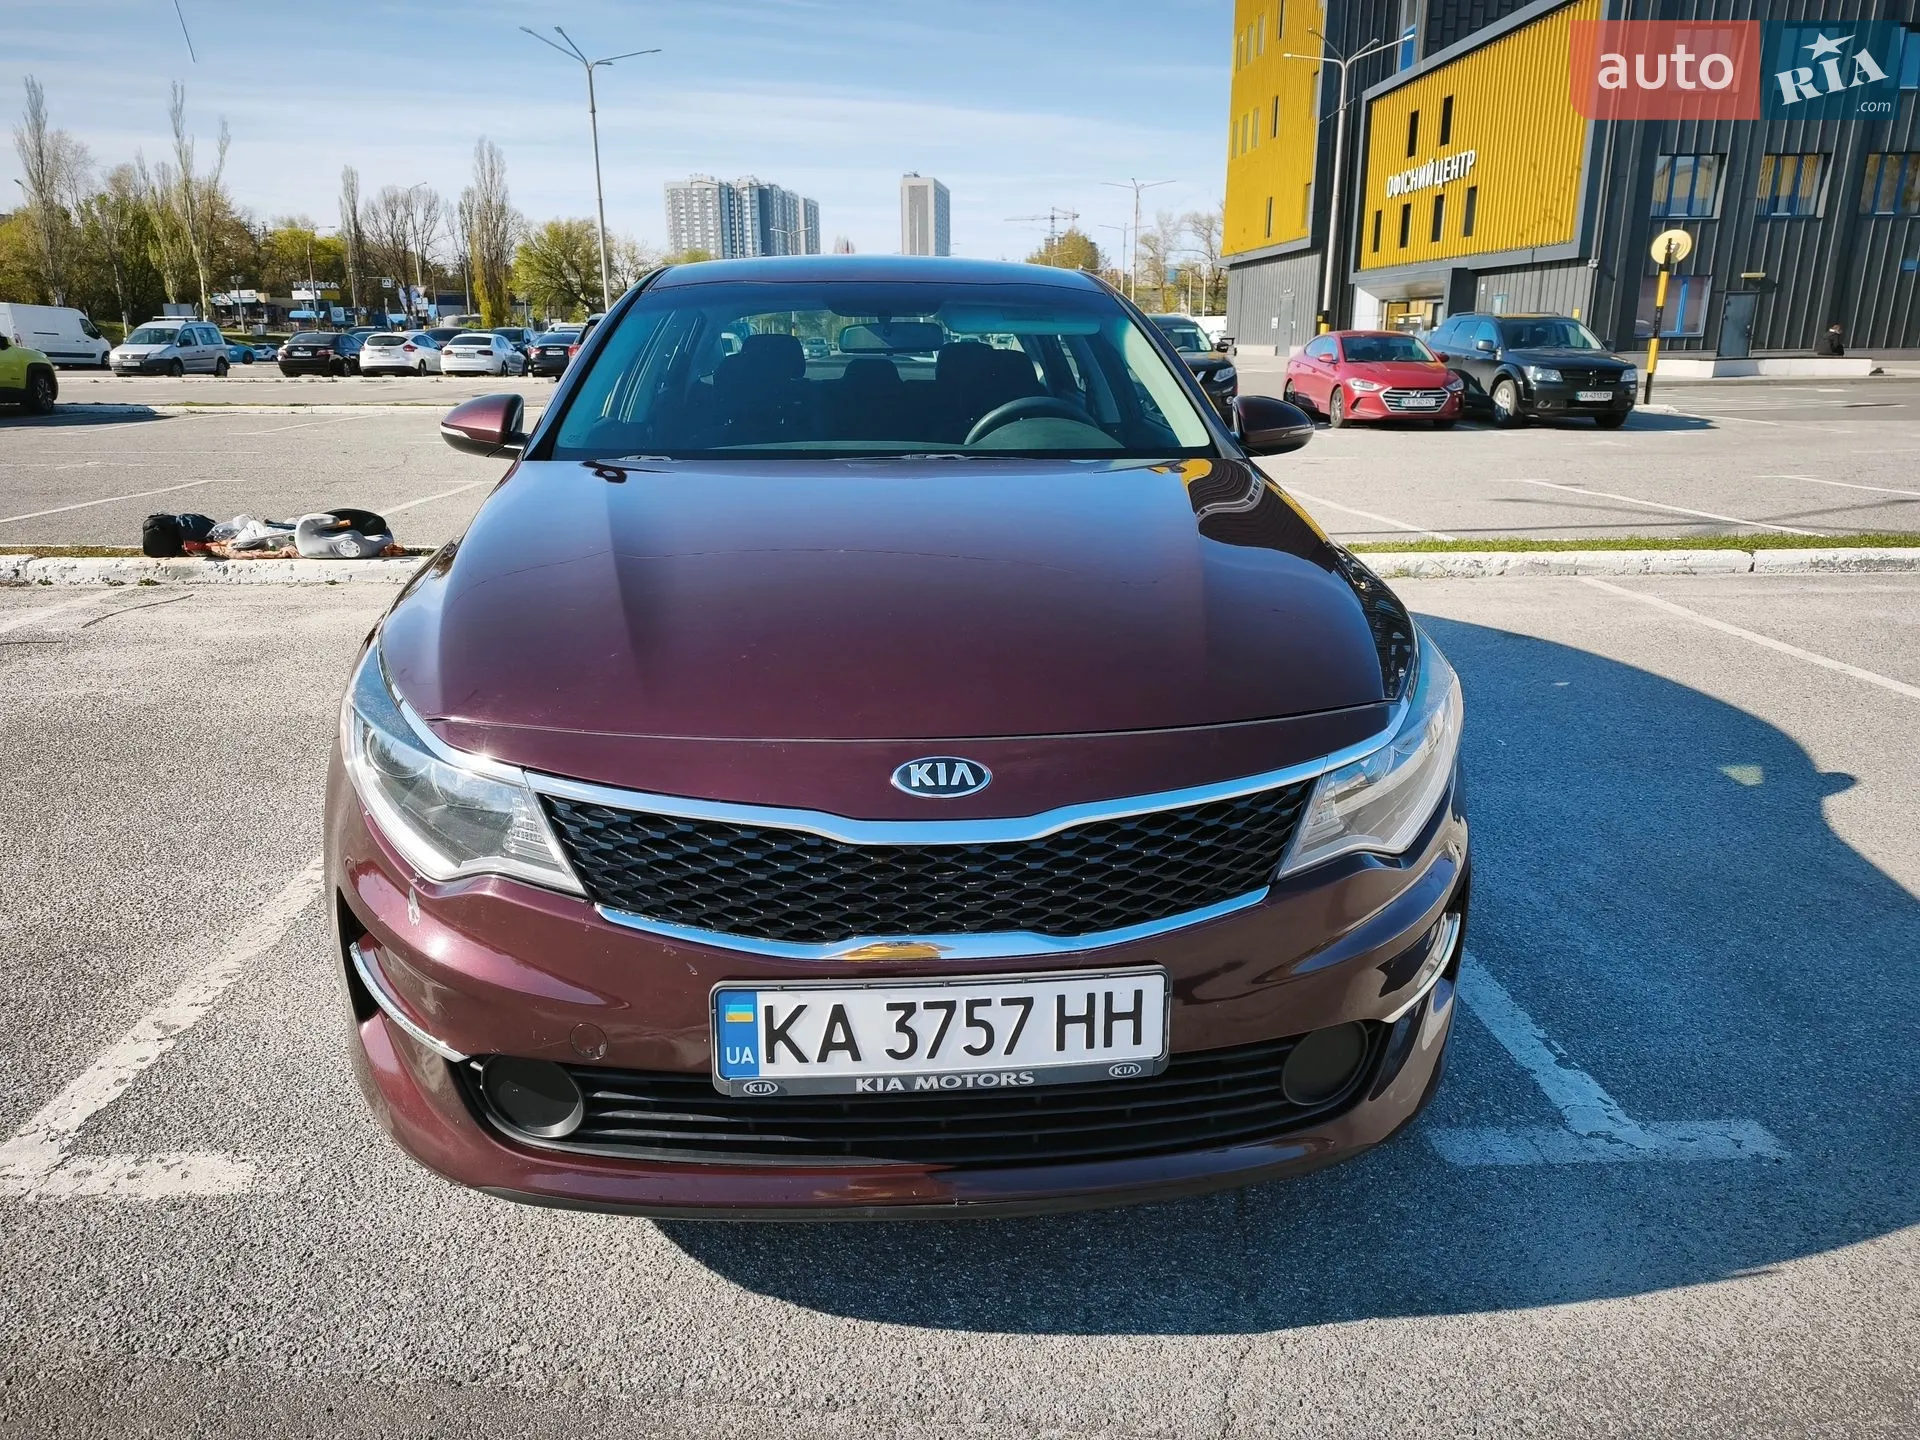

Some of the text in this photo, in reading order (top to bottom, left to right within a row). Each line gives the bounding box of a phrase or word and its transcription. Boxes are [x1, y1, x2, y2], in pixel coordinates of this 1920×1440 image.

[1386, 149, 1476, 198] ОФІСНИЙ ЦЕНТР
[909, 762, 976, 787] KIA
[764, 989, 1144, 1064] KA 3757 HH
[725, 1046, 755, 1065] UA
[1113, 1064, 1138, 1076] KIA
[746, 1082, 776, 1094] KIA
[855, 1071, 1035, 1093] KIA MOTORS
